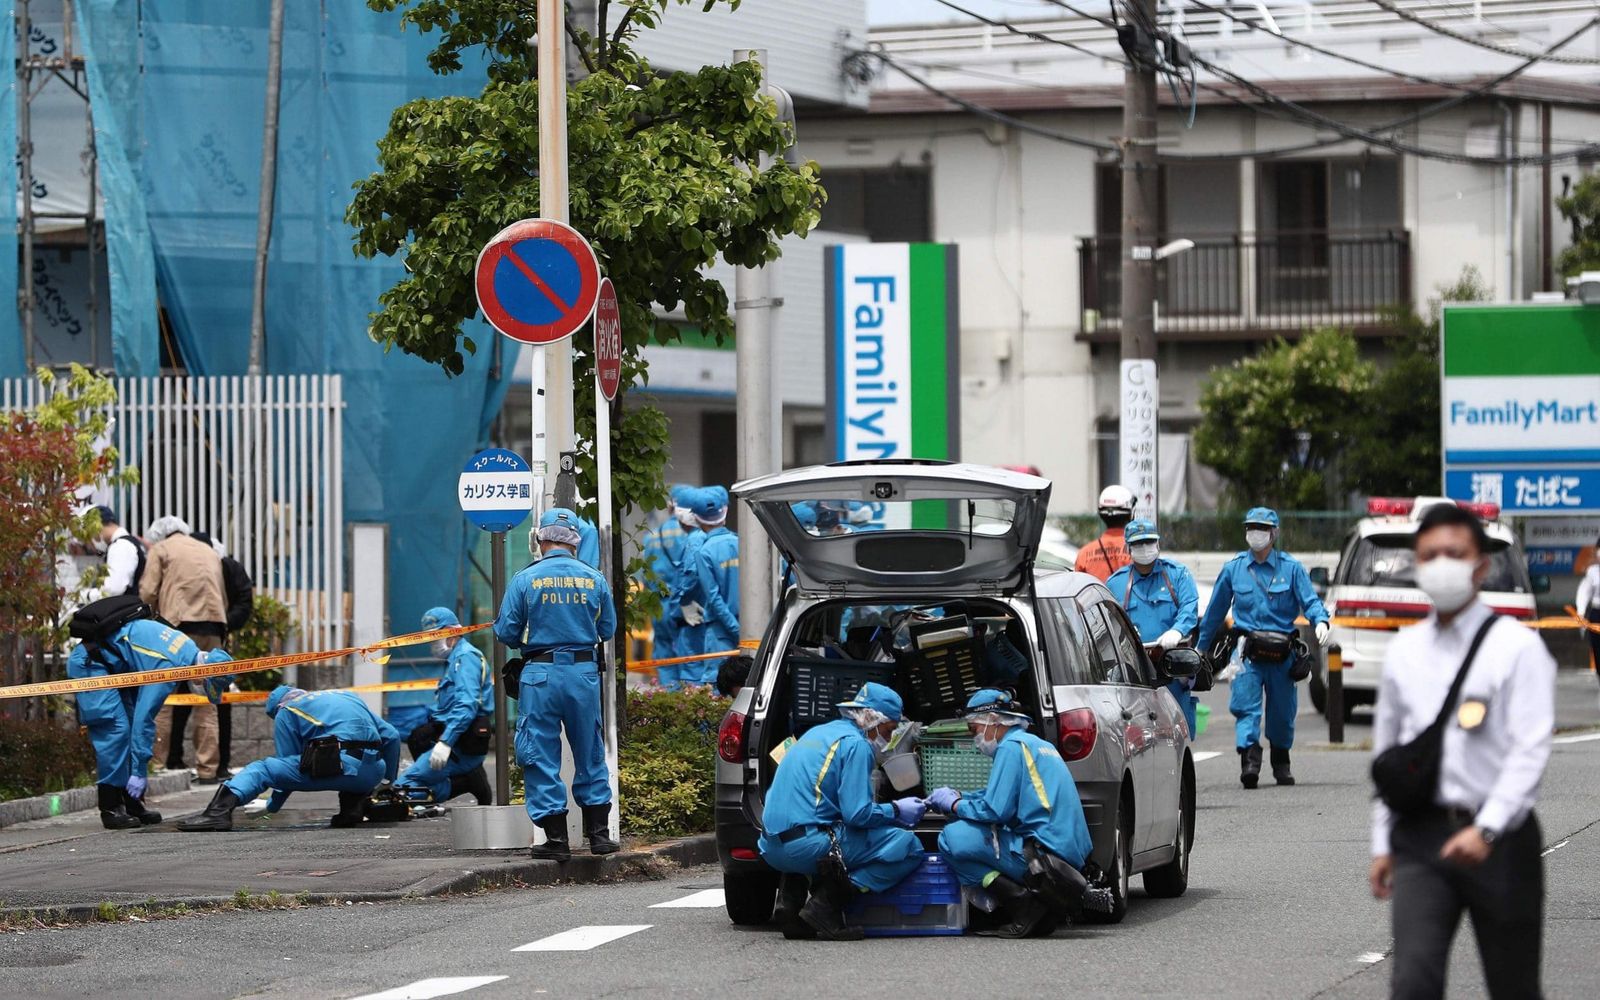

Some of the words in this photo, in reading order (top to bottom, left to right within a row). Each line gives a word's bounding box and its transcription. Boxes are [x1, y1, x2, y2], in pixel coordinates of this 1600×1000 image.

[598, 318, 619, 360] 消火栓
[1451, 400, 1598, 431] FamilyMart
[474, 454, 519, 471] スクールバス
[464, 483, 530, 499] カリタス学園
[1471, 472, 1503, 508] 酒
[1514, 475, 1582, 506] たばこ
[542, 592, 587, 605] POLICE
